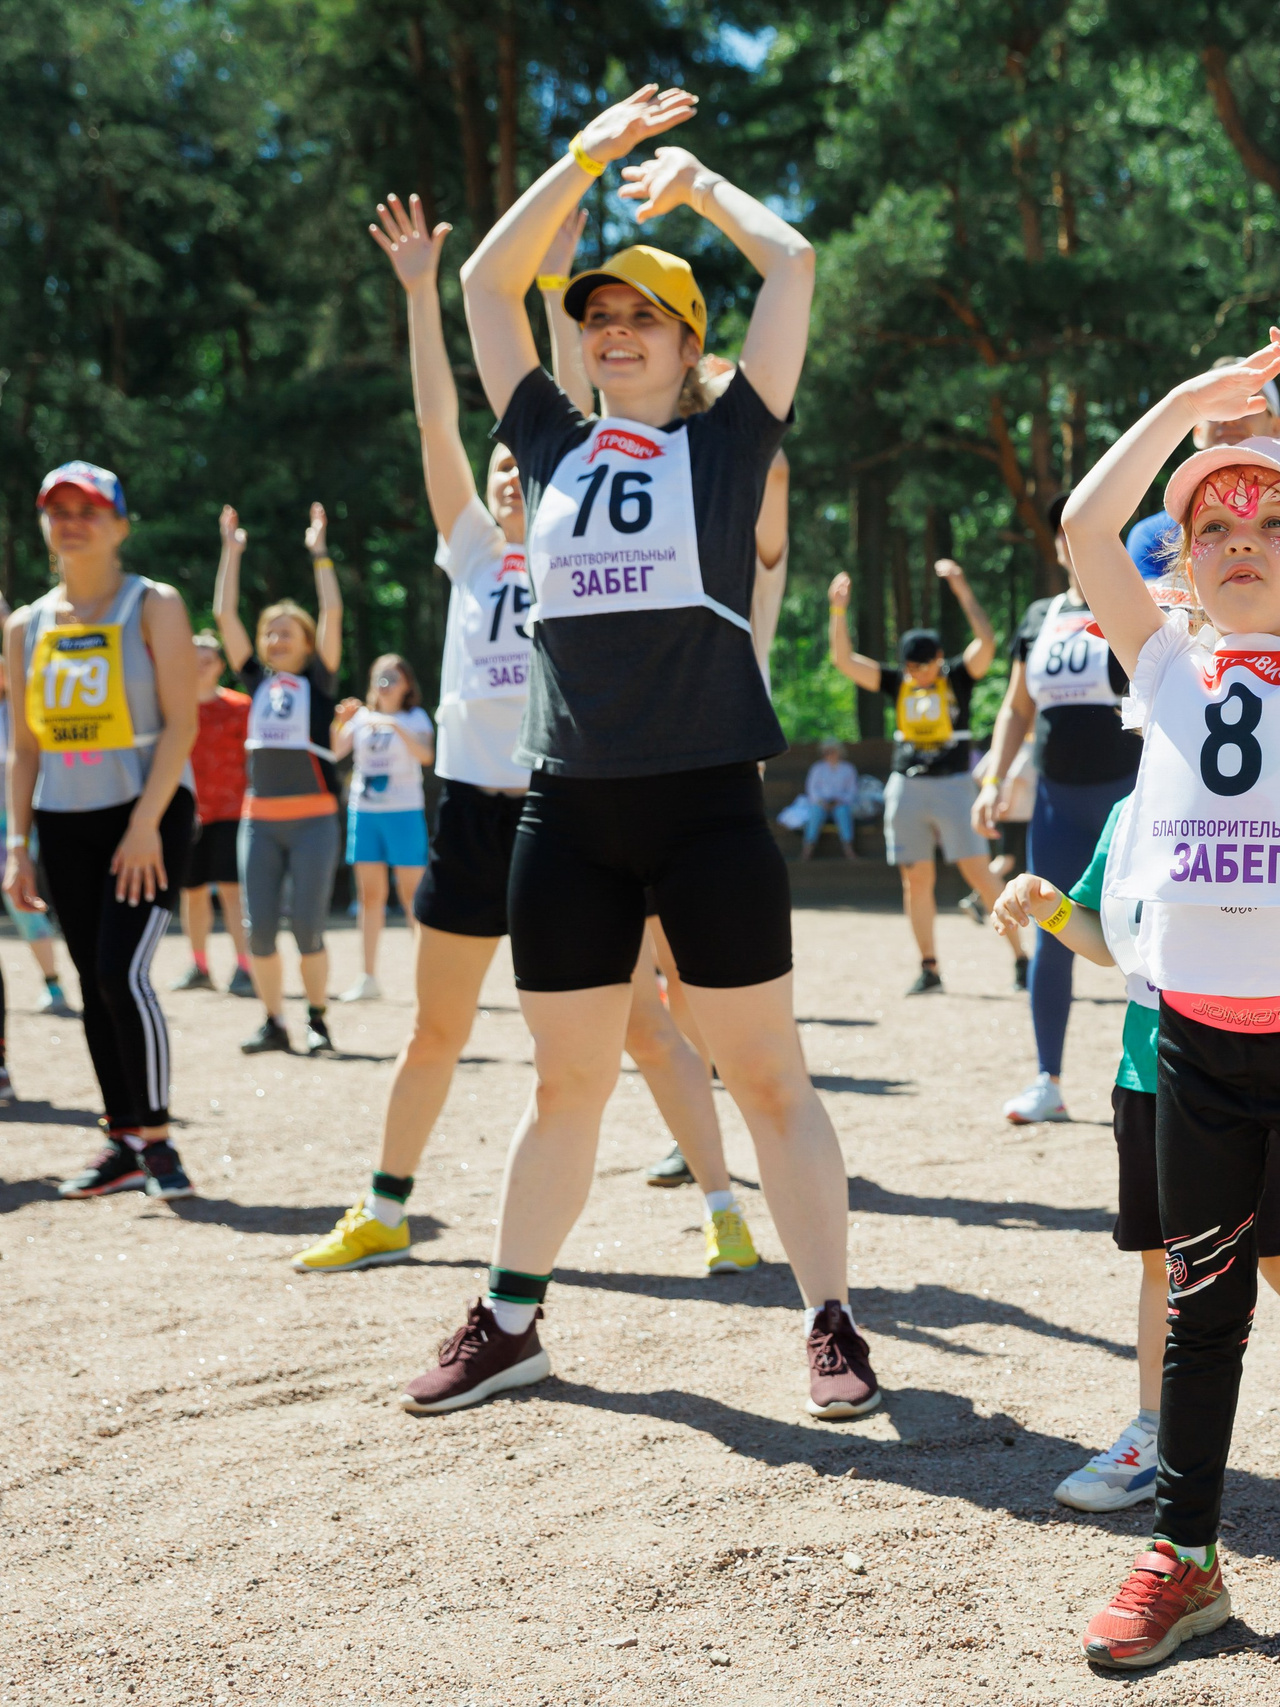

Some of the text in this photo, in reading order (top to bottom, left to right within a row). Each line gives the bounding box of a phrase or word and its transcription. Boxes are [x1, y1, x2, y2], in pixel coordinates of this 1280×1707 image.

[571, 566, 655, 598] ЗАБЕГ
[1046, 640, 1090, 675] 80
[43, 655, 110, 709] 179
[1200, 682, 1263, 796] 8
